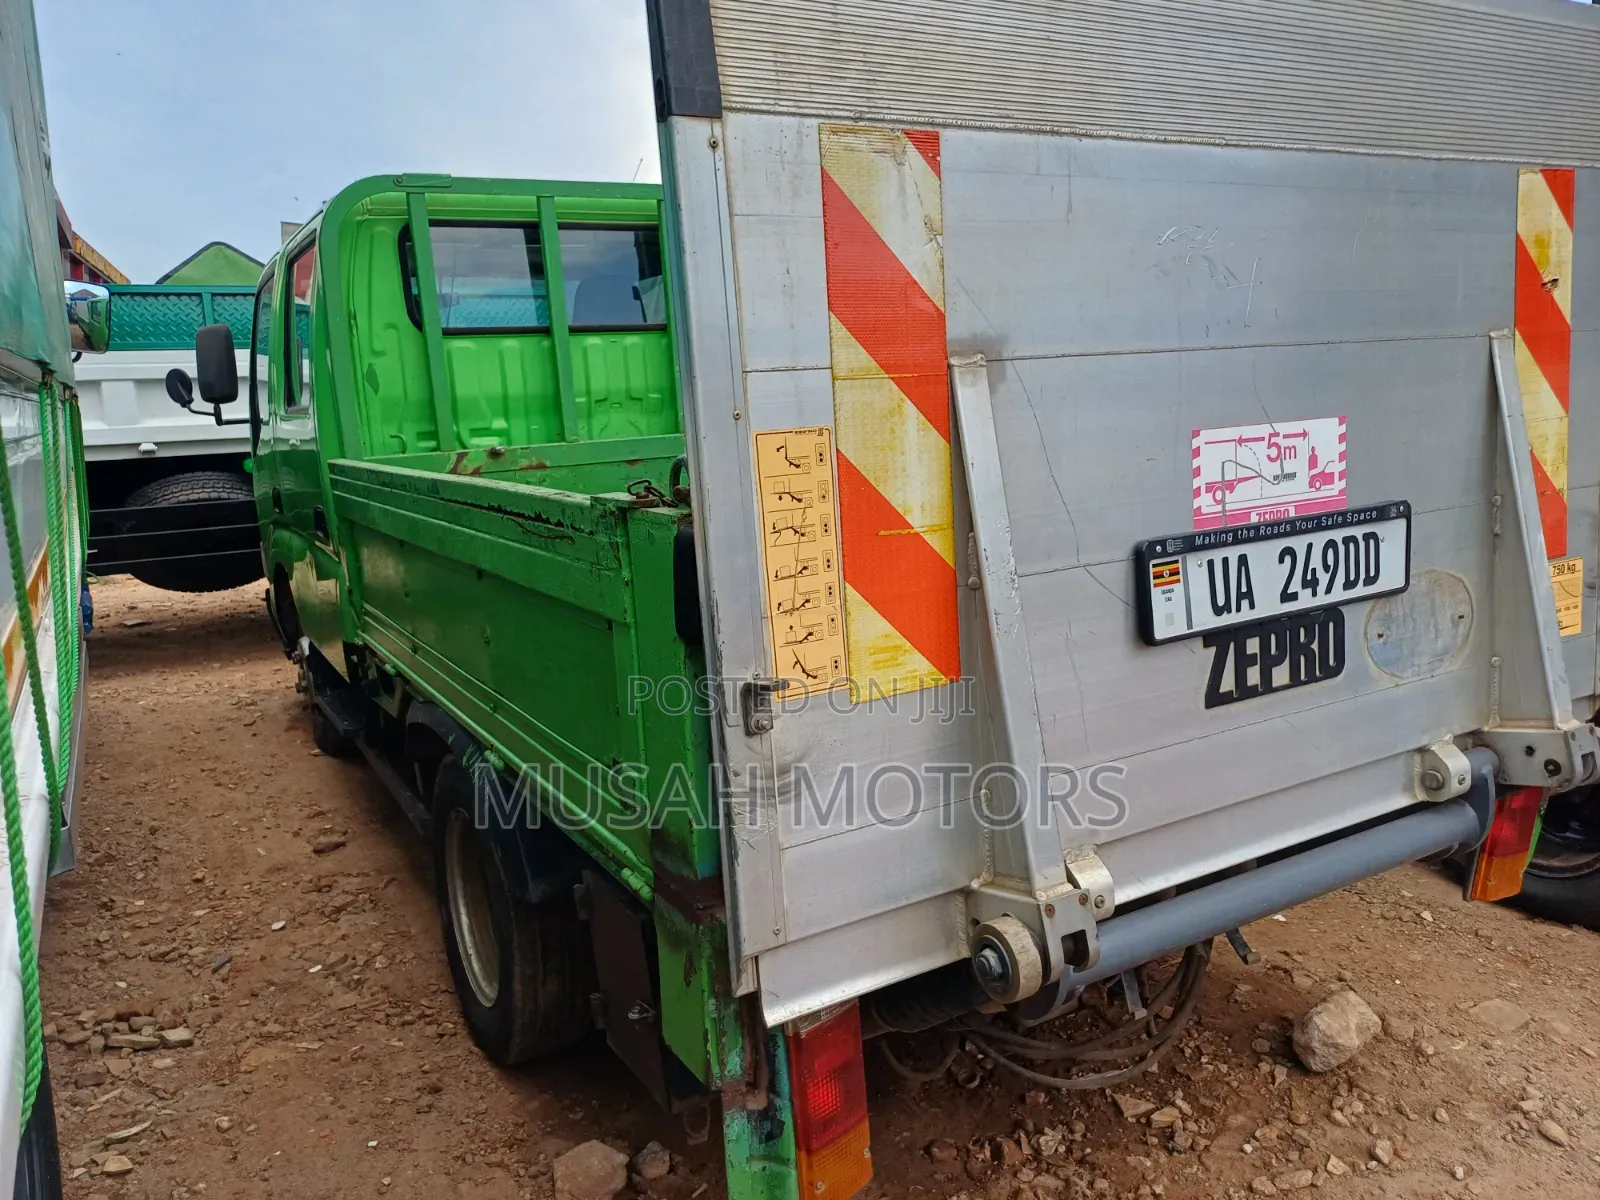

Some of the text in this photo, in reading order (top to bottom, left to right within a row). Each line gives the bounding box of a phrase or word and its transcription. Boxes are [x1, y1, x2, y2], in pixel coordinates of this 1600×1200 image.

[1266, 432, 1297, 463] 5m
[1195, 532, 1233, 546] Making
[1238, 528, 1255, 539] the
[1260, 522, 1291, 536] Roads
[1295, 519, 1318, 530] Your
[1321, 514, 1343, 526] Safe
[1346, 510, 1377, 523] Space
[1206, 531, 1381, 617] UA 249DD
[1552, 562, 1576, 575] 750 kg
[1203, 607, 1346, 709] ZEPRO
